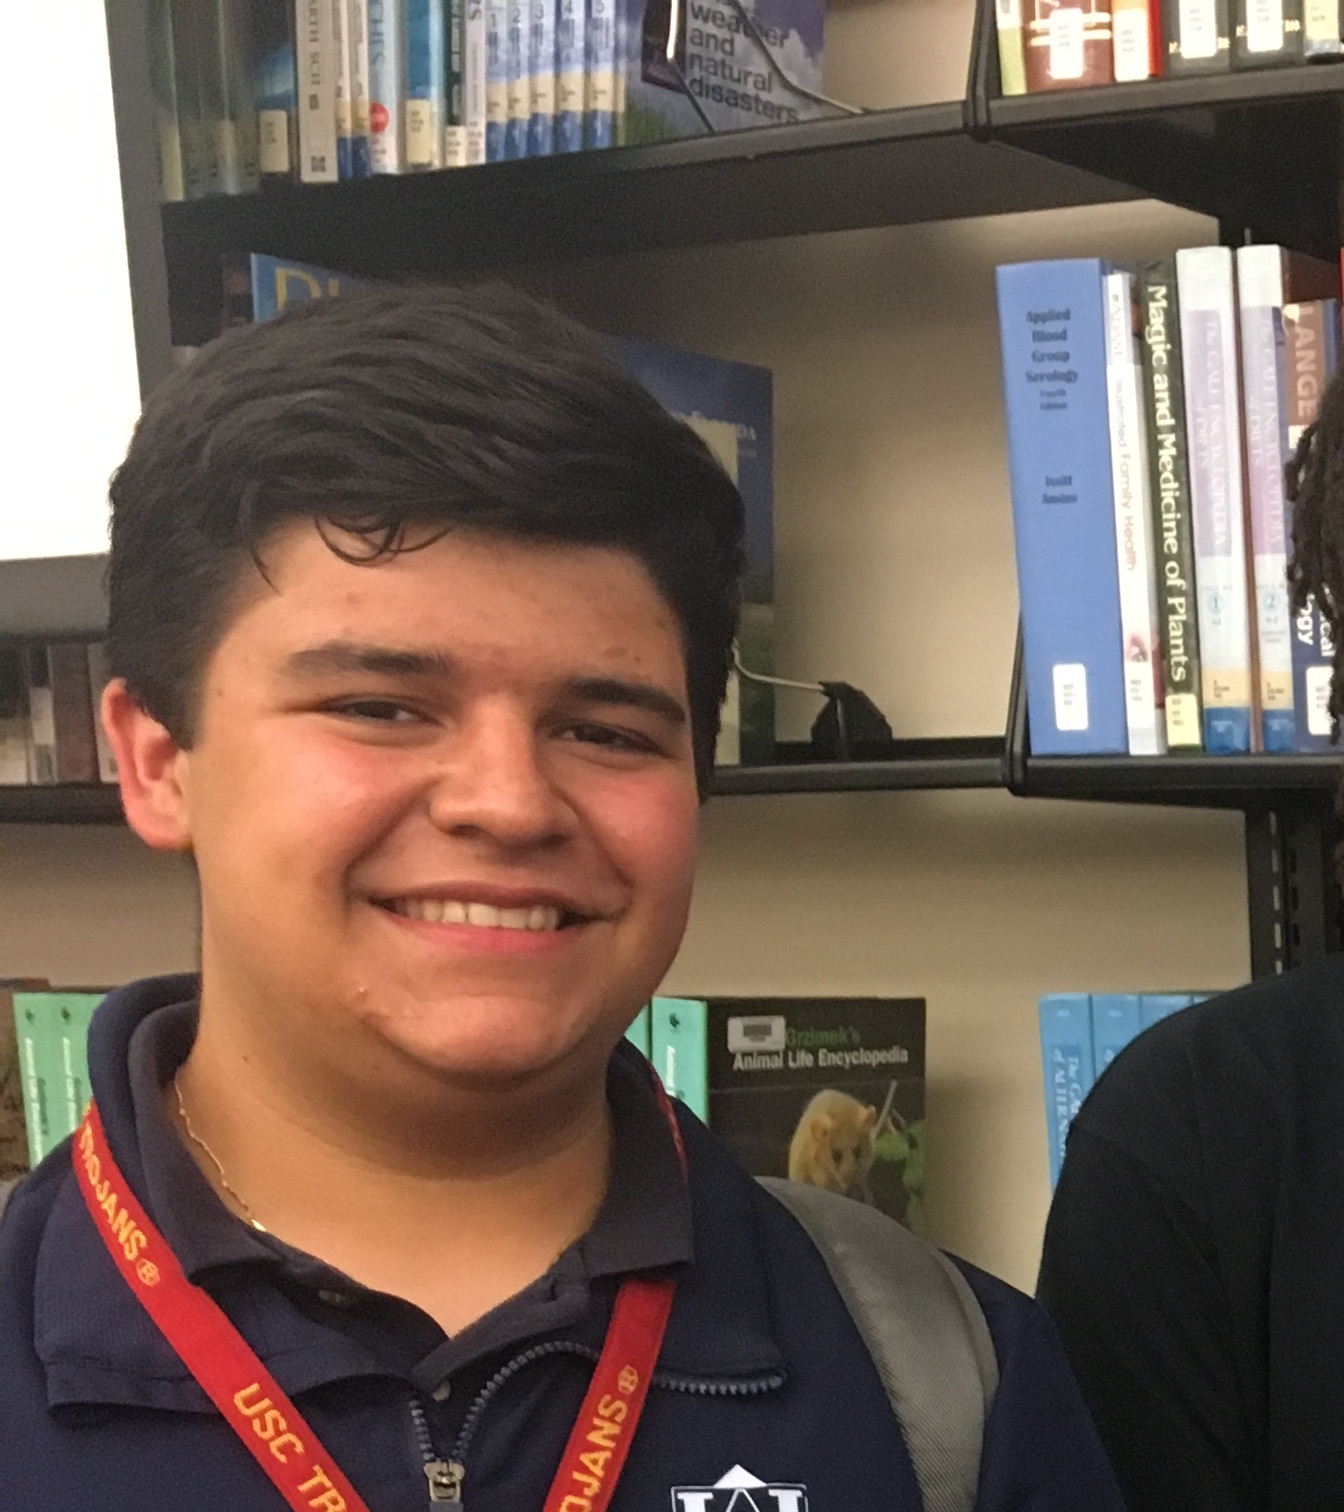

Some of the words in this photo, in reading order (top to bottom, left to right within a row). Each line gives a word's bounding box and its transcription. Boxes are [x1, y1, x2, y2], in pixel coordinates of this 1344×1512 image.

[690, 23, 735, 56] and
[689, 51, 774, 94] natural
[690, 76, 799, 124] disasters
[1145, 284, 1172, 367] Magic
[1293, 304, 1318, 418] LANGE
[1152, 373, 1177, 426] and
[1157, 433, 1181, 555] Medicine
[1164, 560, 1187, 598] of
[1167, 596, 1187, 683] Plants
[733, 1051, 784, 1071] Animal
[787, 1049, 814, 1067] Life
[818, 1045, 909, 1068] Encyclopedia
[233, 1383, 305, 1464] USC
